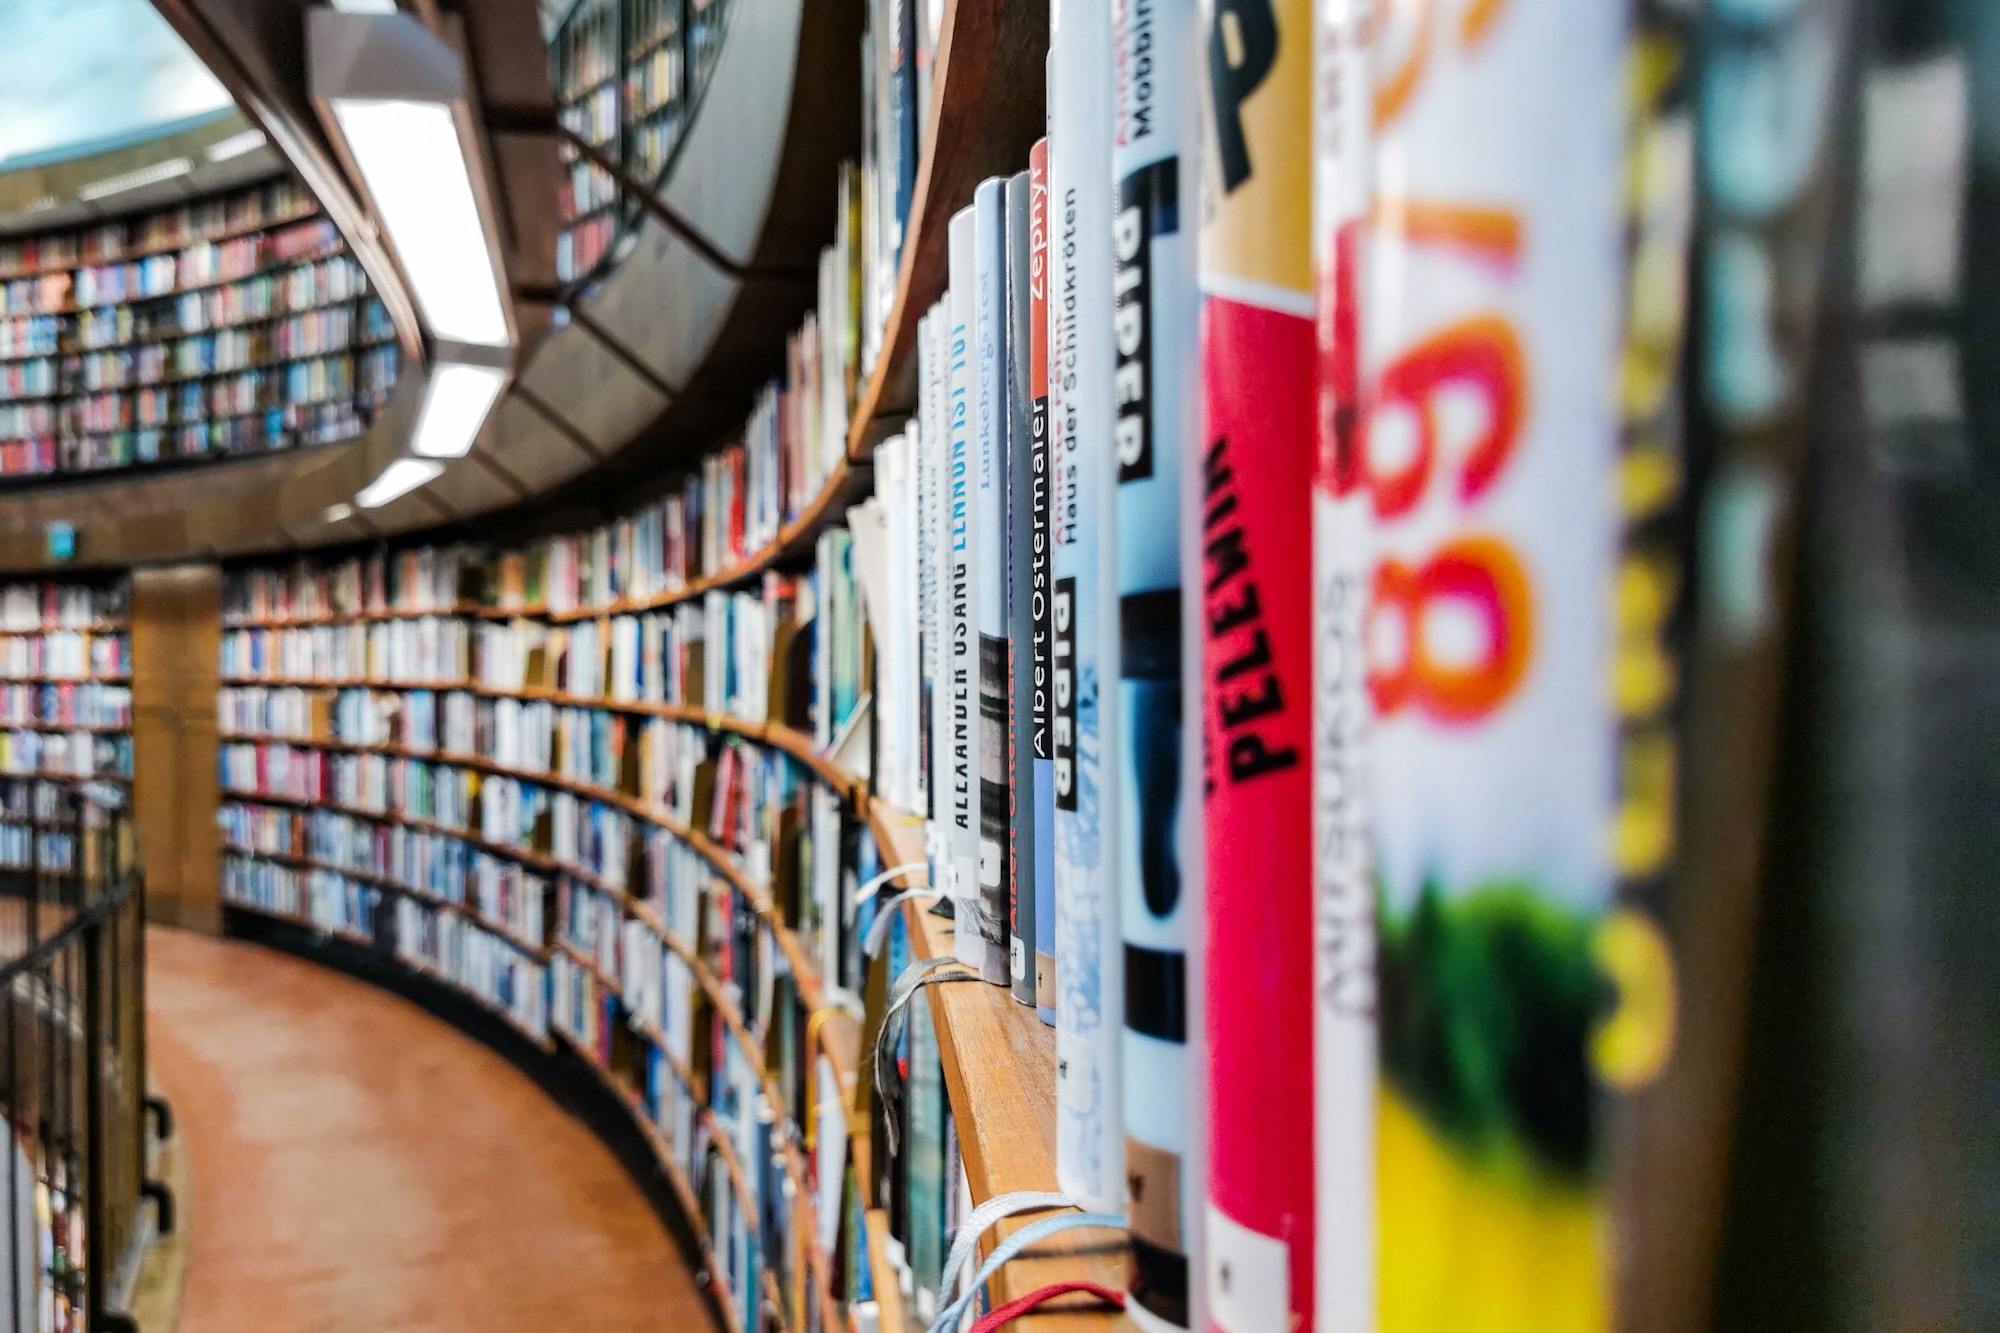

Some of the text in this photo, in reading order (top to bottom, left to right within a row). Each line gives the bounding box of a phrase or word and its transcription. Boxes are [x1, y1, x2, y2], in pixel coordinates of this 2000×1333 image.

[1030, 166, 1047, 301] Zephyr
[1064, 187, 1077, 546] Haus der Schildkröten
[952, 440, 966, 551] LENNON
[1031, 400, 1046, 758] Albert Ostermaier
[953, 669, 968, 830] ALEXANDER
[1008, 638, 1017, 933] Albert Ostermaier
[1055, 591, 1072, 797] PIPER
